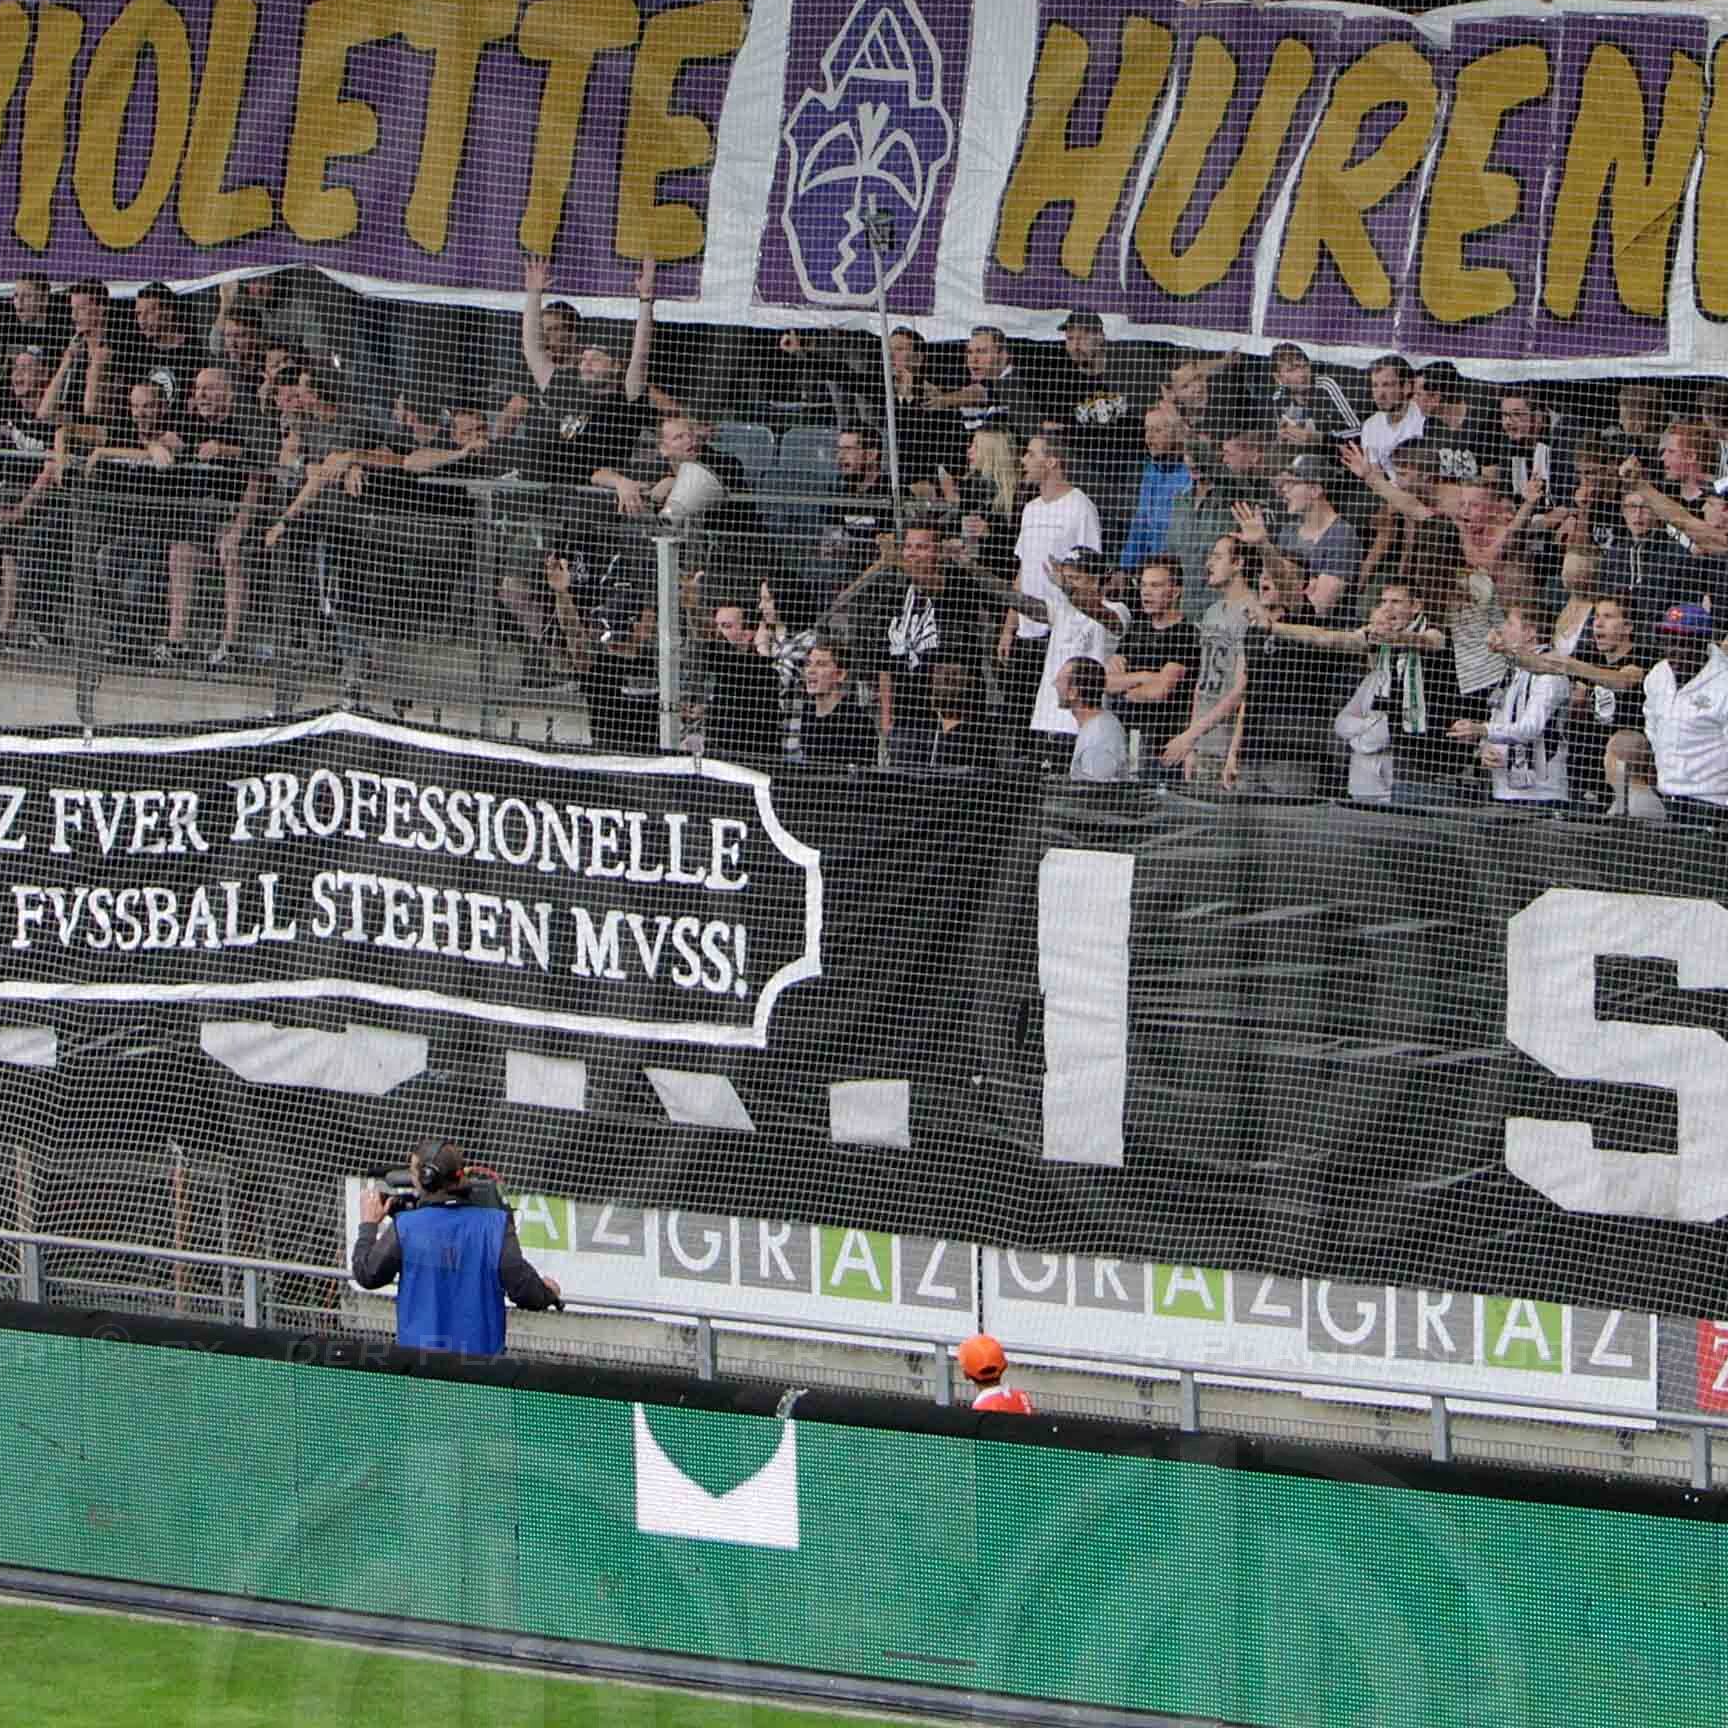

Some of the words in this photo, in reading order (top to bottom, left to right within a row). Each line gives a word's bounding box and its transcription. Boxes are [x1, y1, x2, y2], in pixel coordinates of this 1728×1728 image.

[48, 787, 209, 857] FVER
[229, 766, 751, 892] PROFESSIONELLE
[12, 874, 298, 953] FVSSBALL
[310, 870, 551, 972] STEHEN
[570, 906, 751, 998] MVSS!
[667, 1209, 969, 1302] GRAZ
[1319, 1282, 1636, 1369] GRAZ
